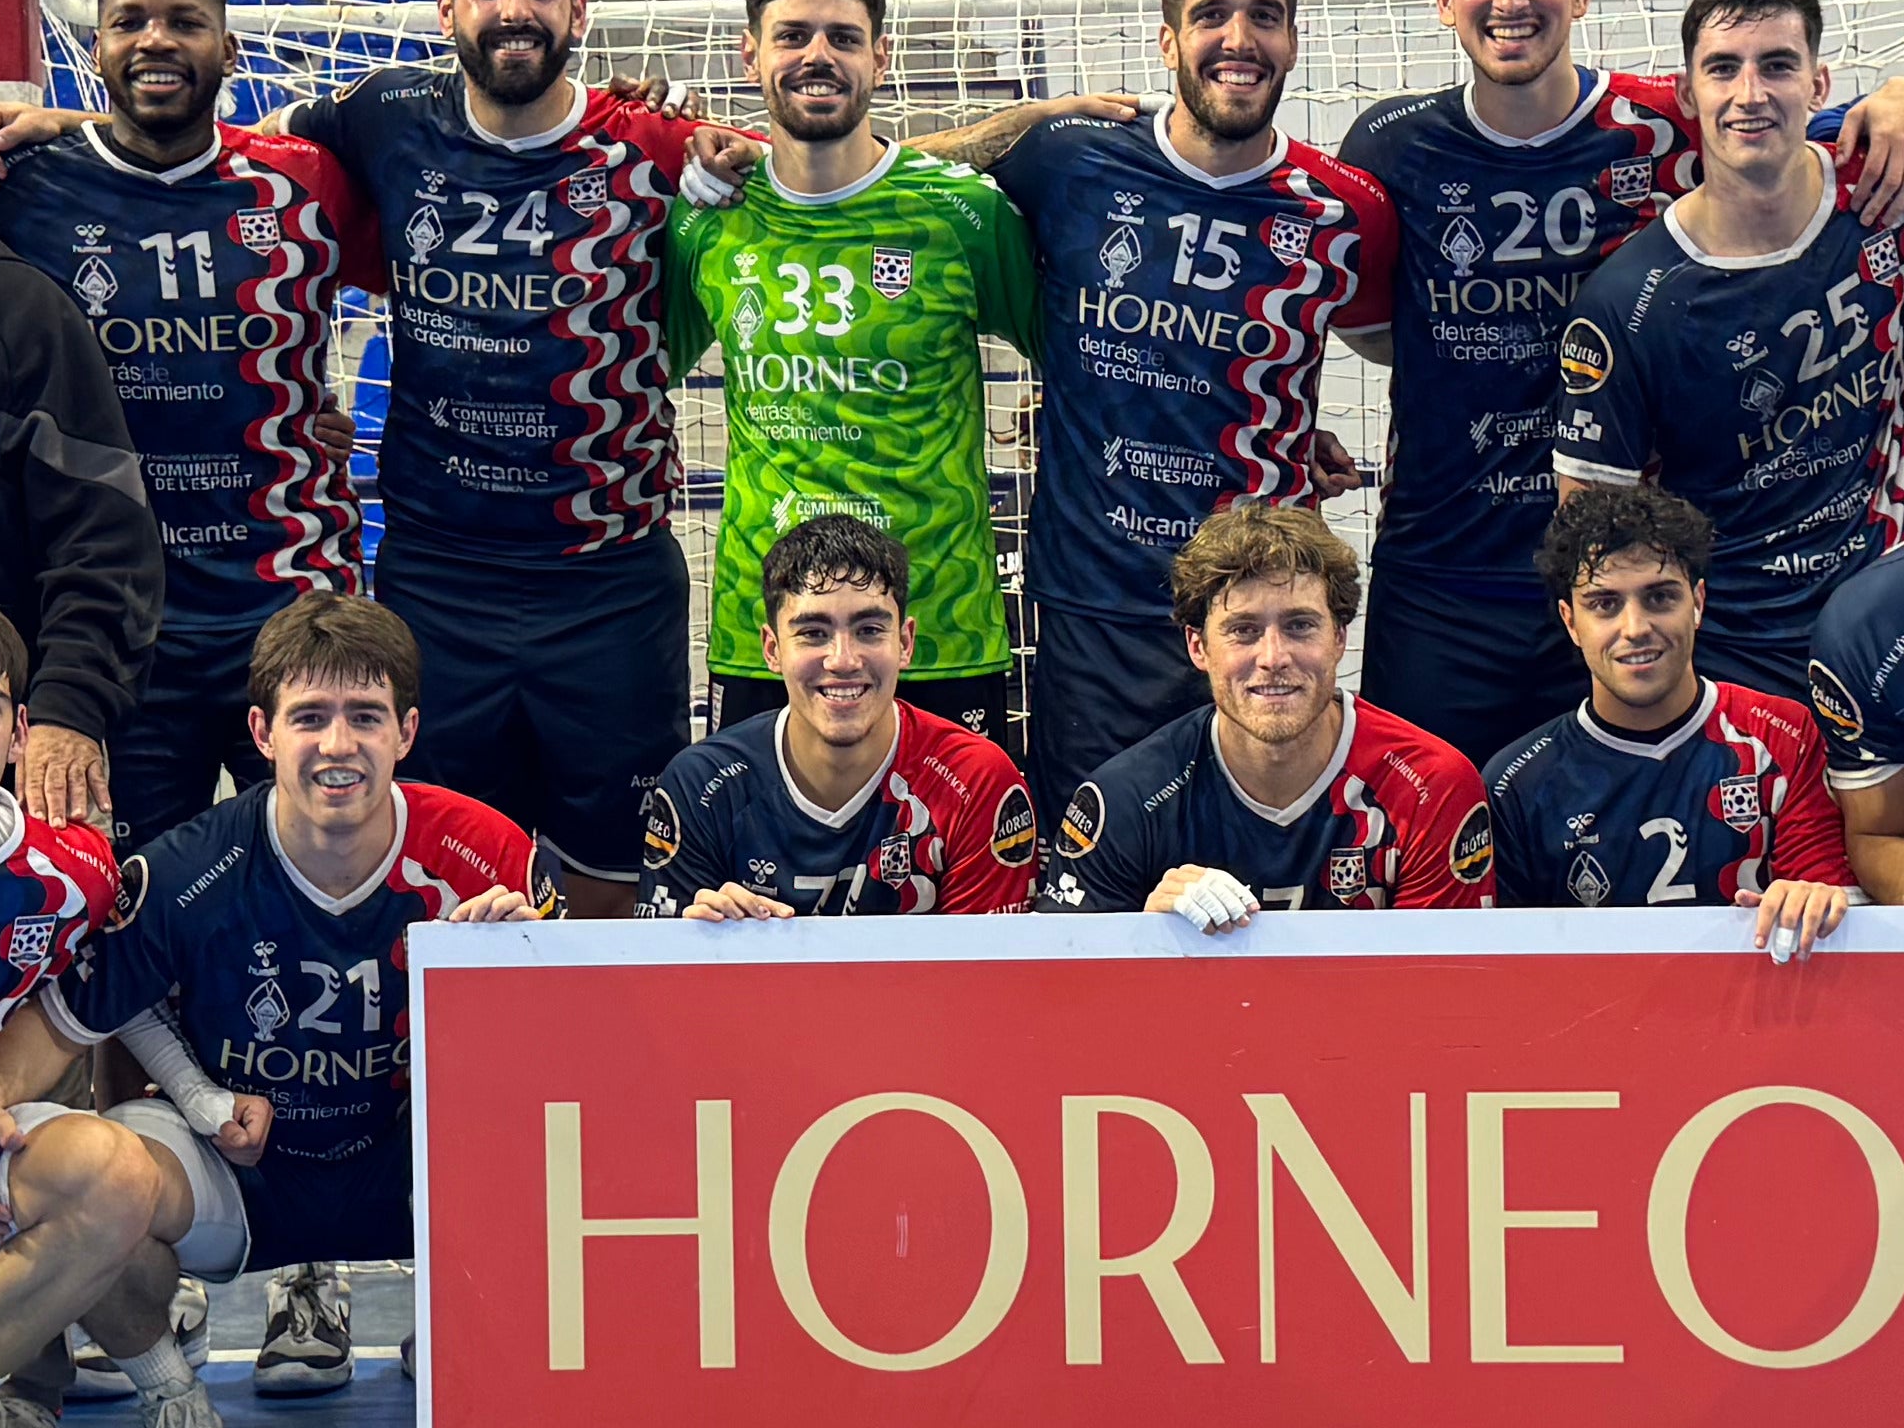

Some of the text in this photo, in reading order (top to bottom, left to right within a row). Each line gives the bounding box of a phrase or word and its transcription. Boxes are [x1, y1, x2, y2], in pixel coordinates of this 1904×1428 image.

[452, 190, 554, 257] 24
[1490, 186, 1597, 262] 20
[139, 230, 217, 300] 11
[1167, 212, 1247, 291] 15
[392, 260, 593, 311] HORNEO
[773, 263, 856, 337] 33
[1427, 272, 1587, 315] HORN
[89, 313, 278, 354] ORNEO
[1079, 286, 1277, 358] HORNEO
[1781, 272, 1870, 383] 25
[109, 362, 141, 381] rás
[114, 381, 224, 402] ecimiento
[734, 353, 908, 394] HORNEO
[451, 407, 547, 424] COMUNITAT
[459, 420, 480, 434] DE
[147, 461, 241, 477] COMUNITAT
[440, 455, 549, 483] Alicante
[1125, 448, 1214, 474] COMUNITAT
[1130, 465, 1224, 489] DE L'ESPORT
[155, 474, 253, 491] DE L'ESPORT
[162, 521, 248, 544] licante
[1106, 504, 1200, 538] Alicant
[1639, 817, 1696, 904] 2
[298, 958, 381, 1034] 21
[274, 1101, 372, 1120] cimiento
